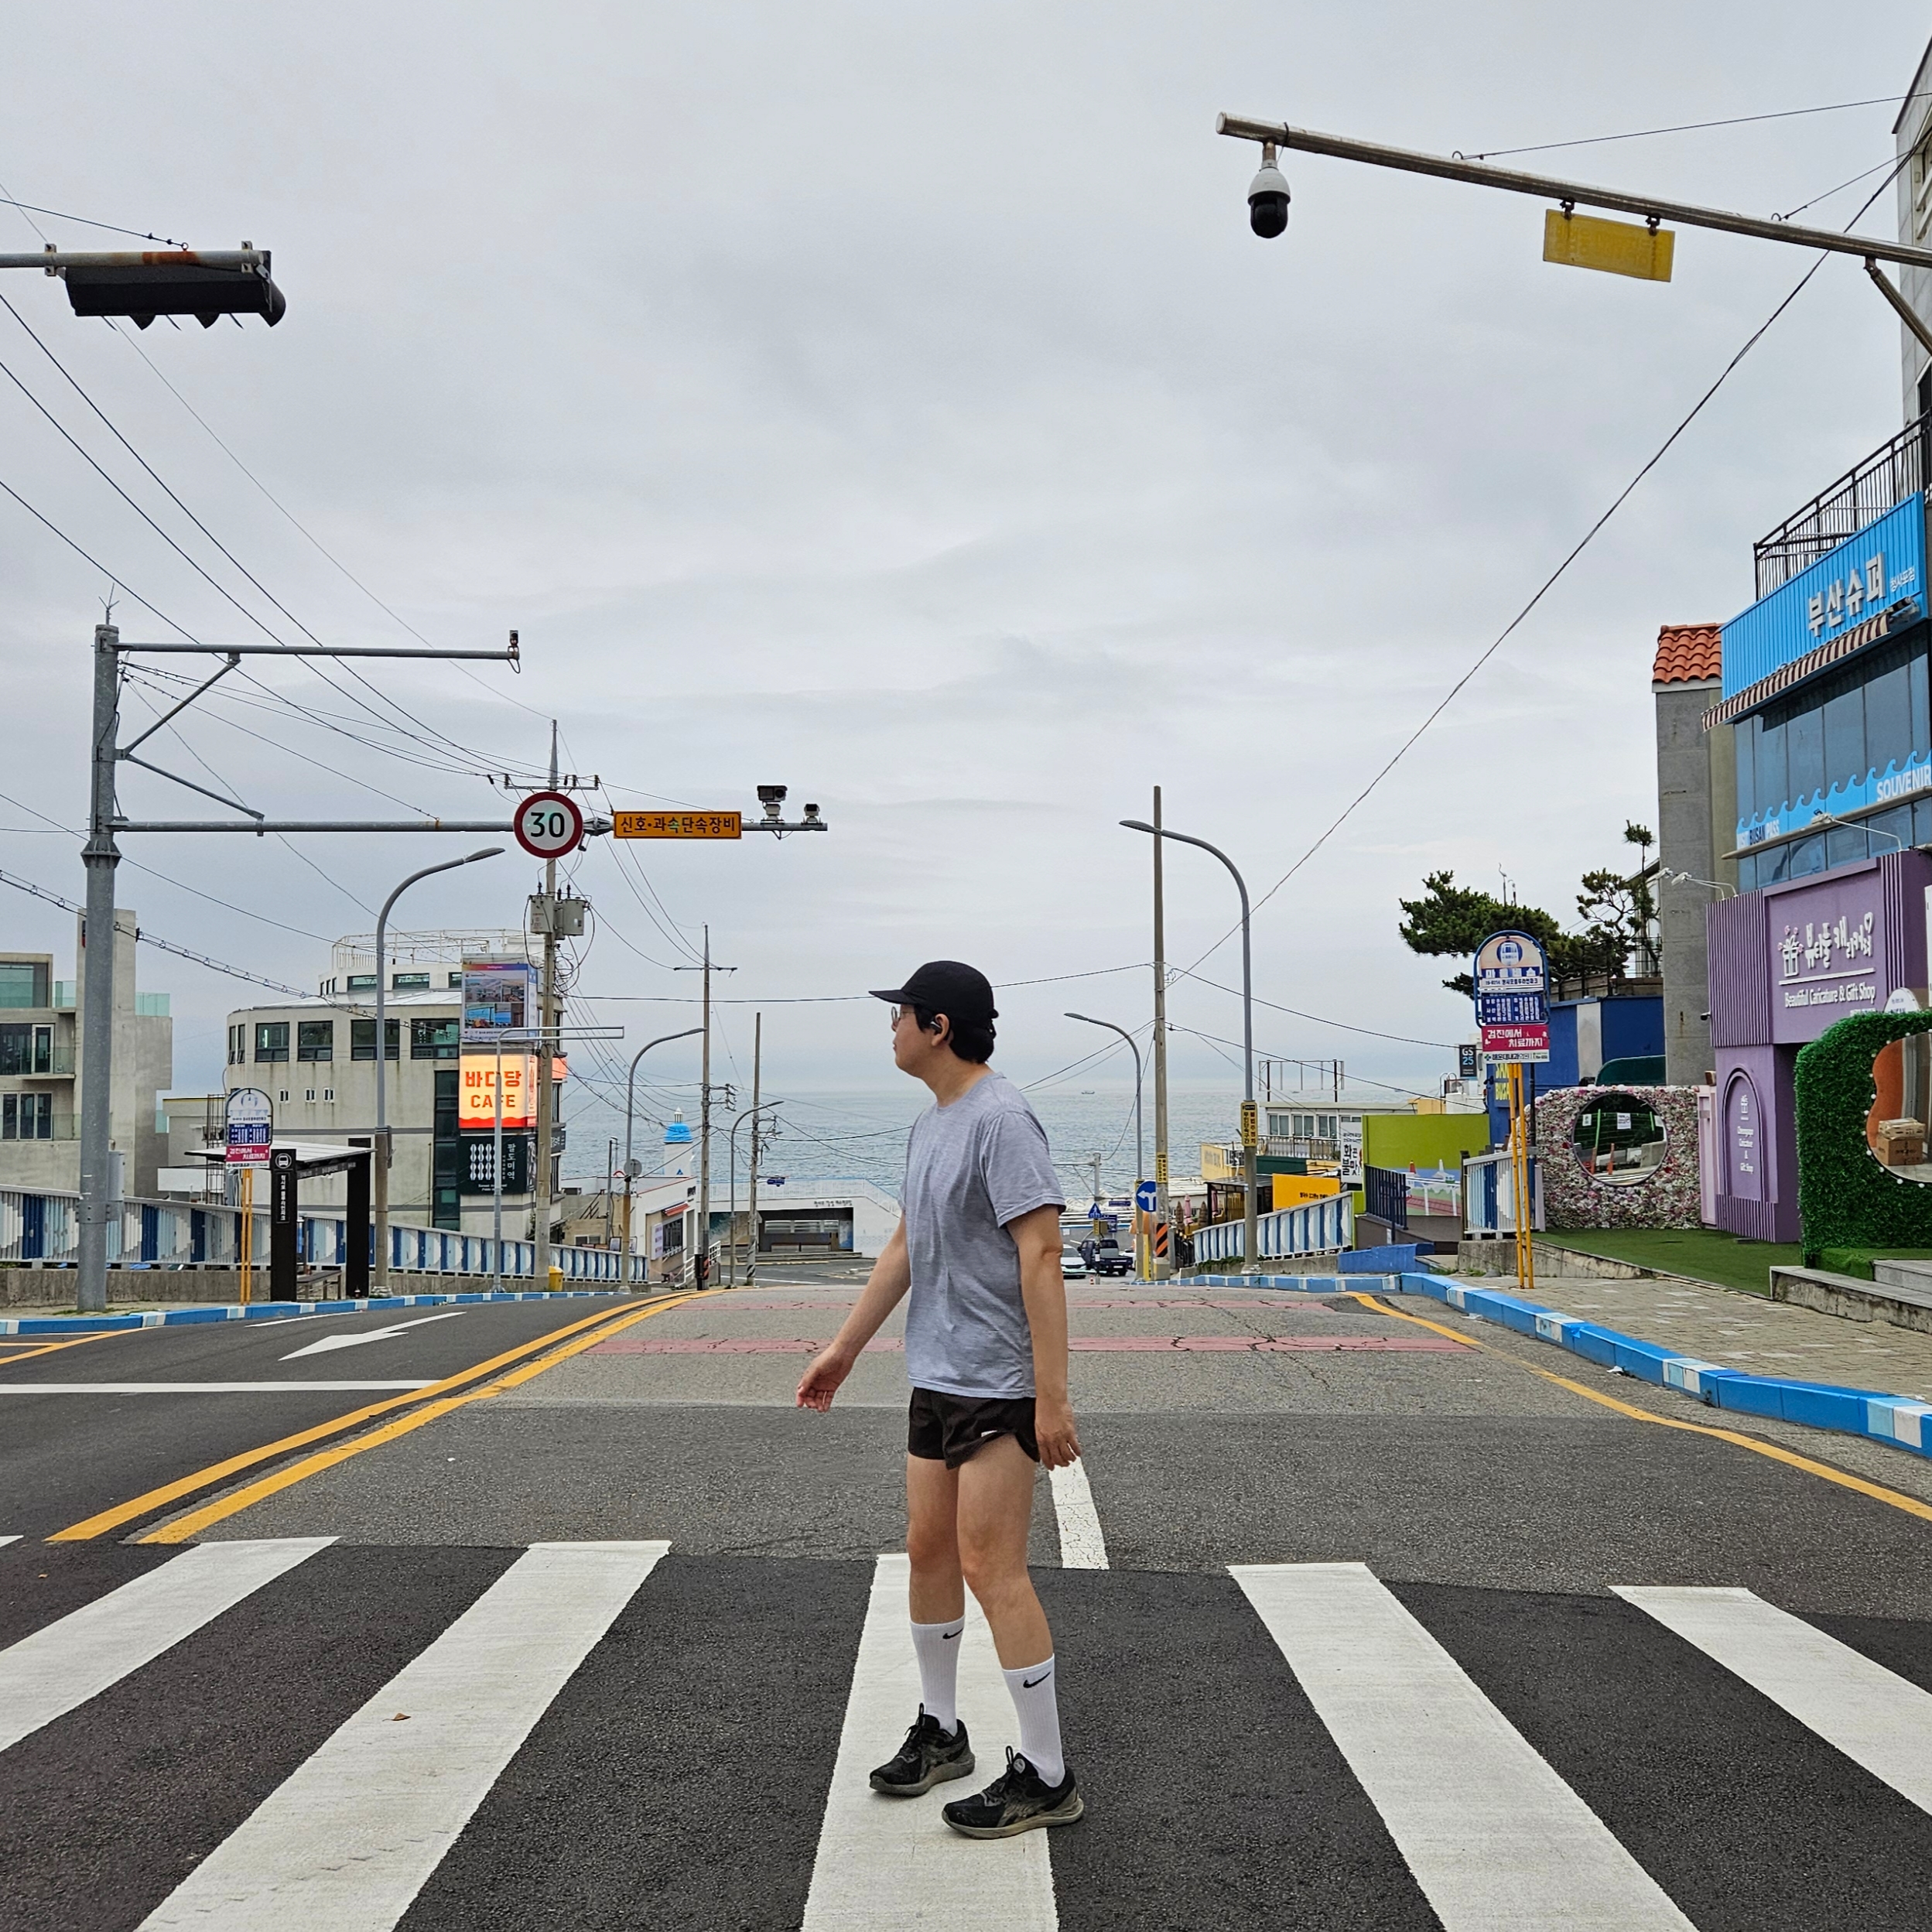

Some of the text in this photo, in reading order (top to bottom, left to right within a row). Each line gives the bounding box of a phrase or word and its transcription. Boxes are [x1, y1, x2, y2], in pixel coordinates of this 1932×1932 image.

[1808, 552, 1886, 637] 부산슈퍼
[1876, 764, 1932, 802] SOUVENIR
[530, 812, 565, 838] 30
[621, 816, 735, 834] 신호·과속단속장비
[1749, 824, 1765, 846] BUSAN
[1784, 981, 1876, 1007] Beautiful Caricature & Gift Shop
[1487, 1028, 1523, 1038] 검진에서
[1462, 1047, 1474, 1056] GS
[1508, 1038, 1543, 1048] 치료까지
[1462, 1056, 1474, 1065] 25
[507, 1143, 516, 1180] 팔도미역
[1343, 1144, 1358, 1160] 화끈
[1342, 1157, 1361, 1176] 불맛!
